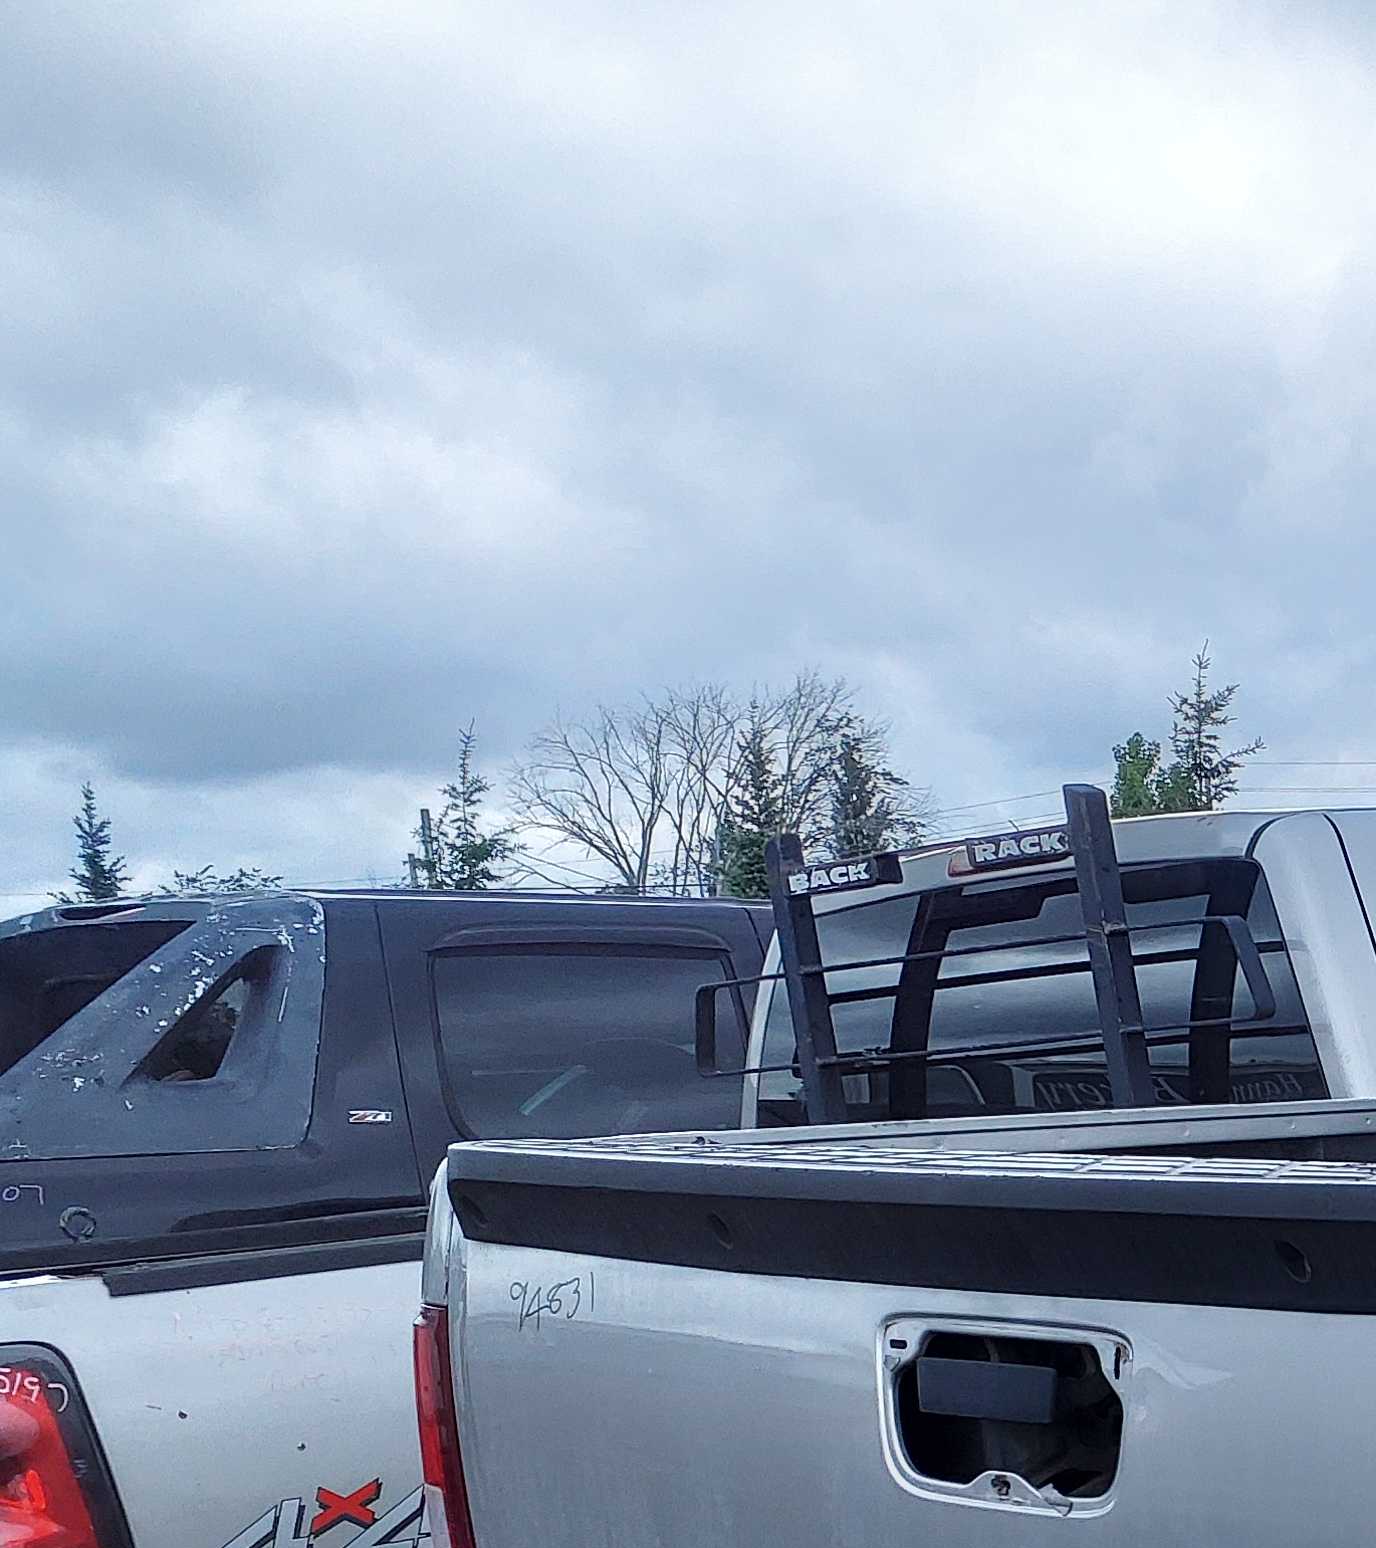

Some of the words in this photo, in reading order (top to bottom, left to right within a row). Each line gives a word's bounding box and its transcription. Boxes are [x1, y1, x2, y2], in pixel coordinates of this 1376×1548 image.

[788, 862, 871, 894] BACK
[974, 831, 1068, 863] RACK
[509, 1271, 594, 1332] 94831
